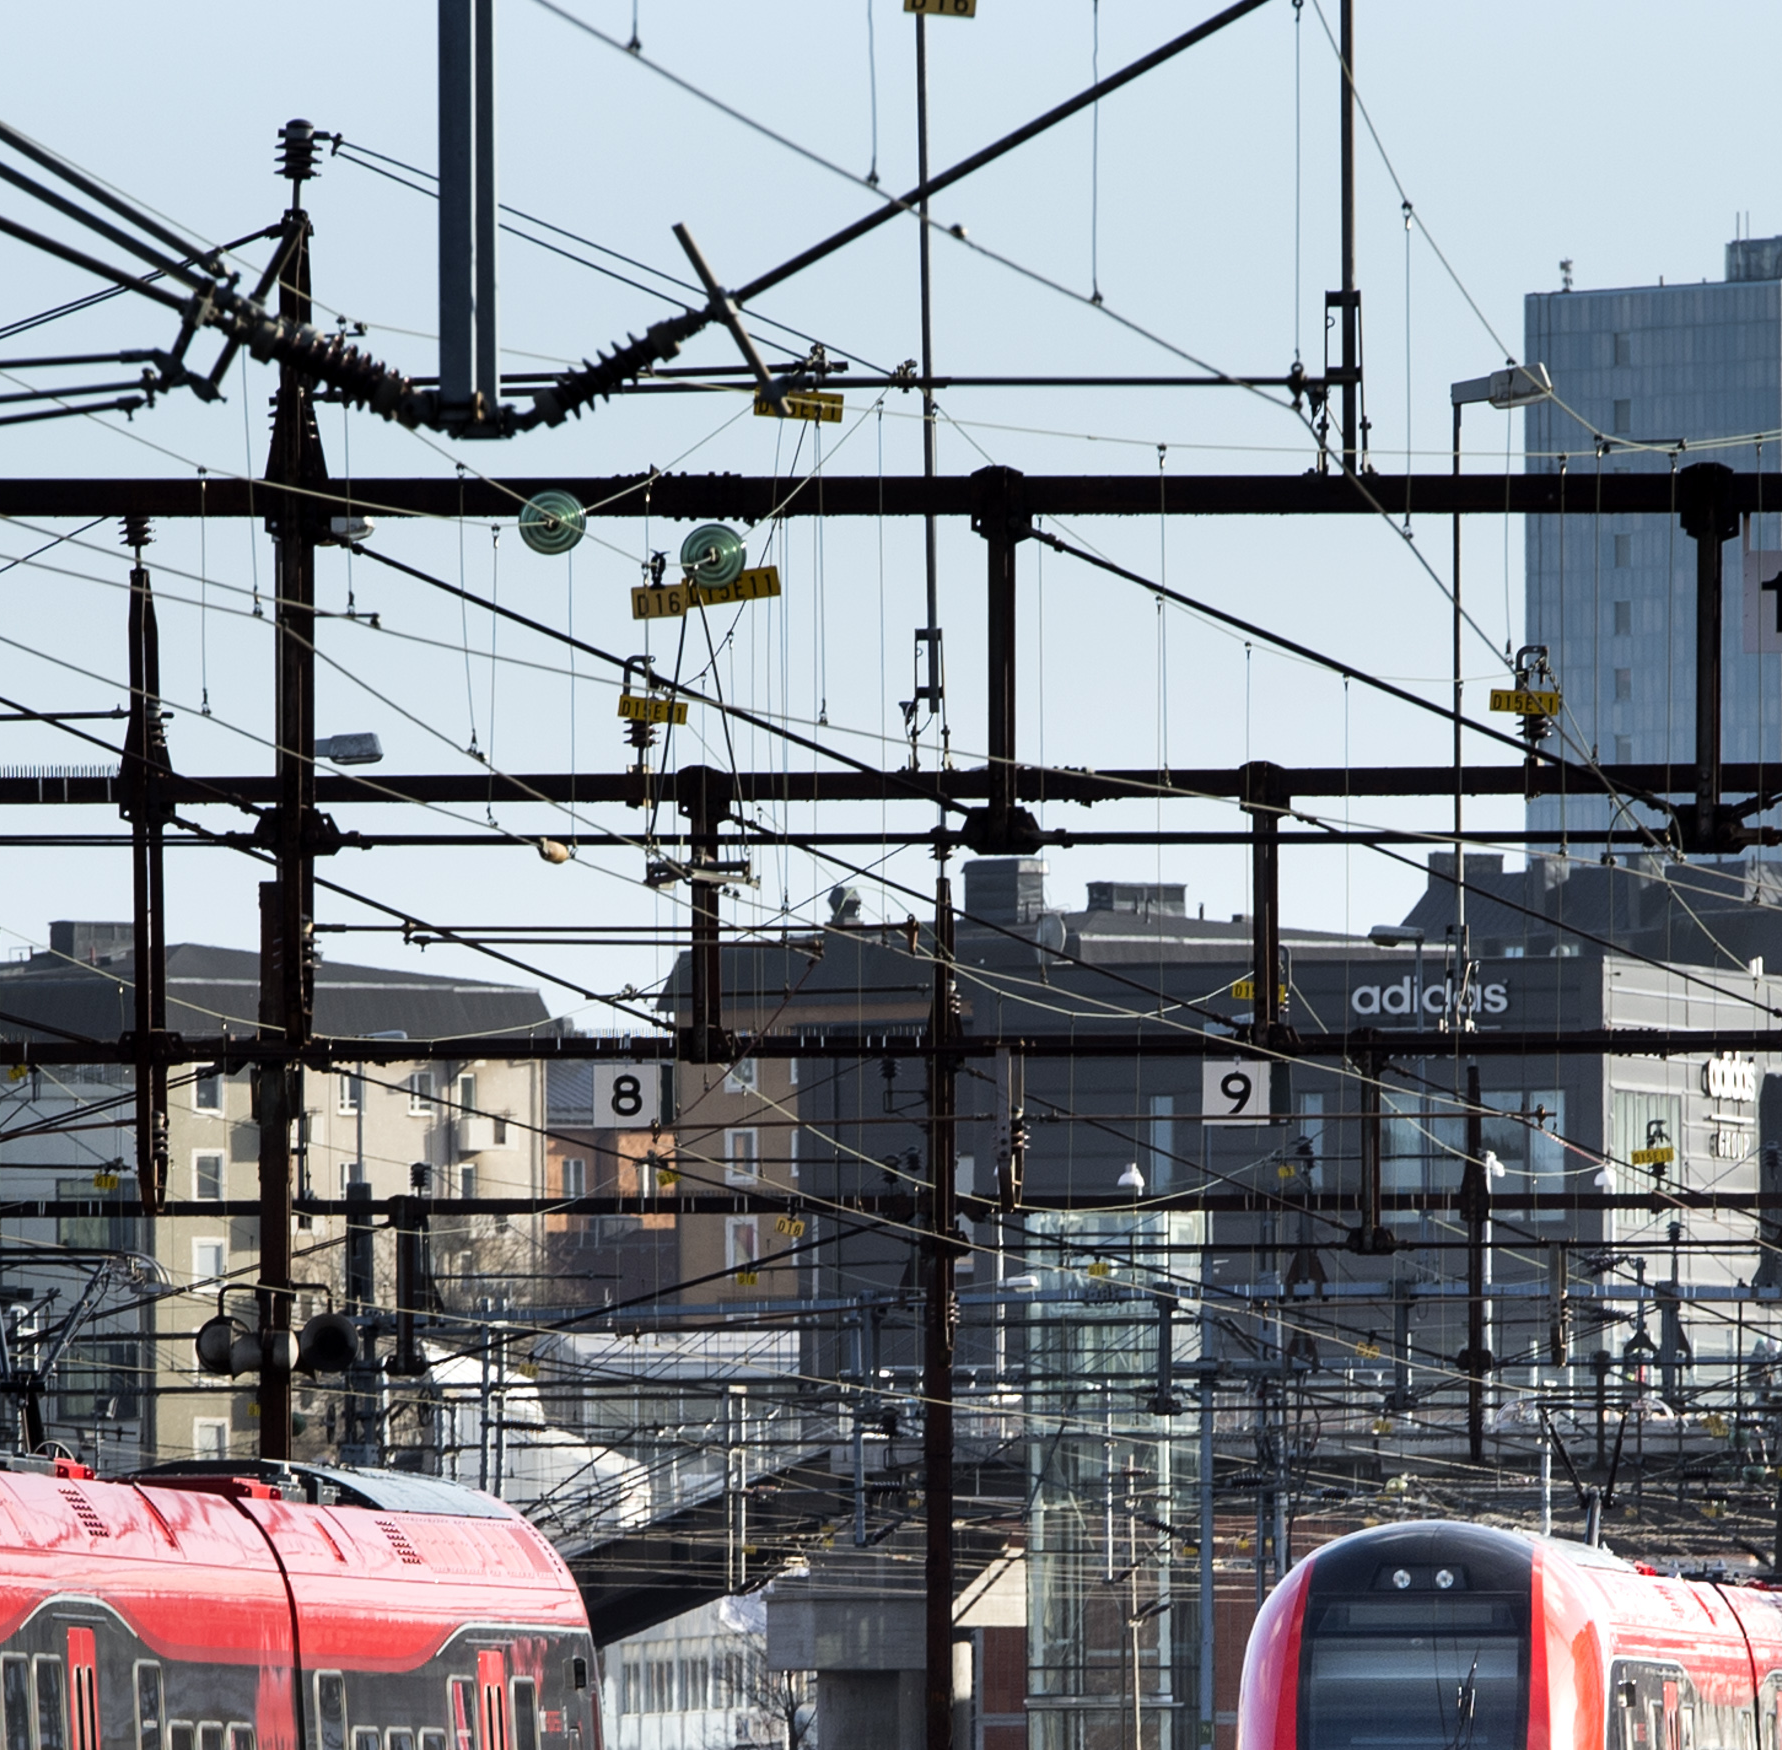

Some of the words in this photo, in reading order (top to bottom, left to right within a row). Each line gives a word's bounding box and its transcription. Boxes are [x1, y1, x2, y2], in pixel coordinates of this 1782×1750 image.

[637, 591, 681, 616] D16
[1493, 693, 1554, 713] D15E11
[1351, 975, 1508, 1015] adidas
[611, 1075, 643, 1117] 8
[1220, 1073, 1252, 1115] 9
[778, 1217, 802, 1236] D18
